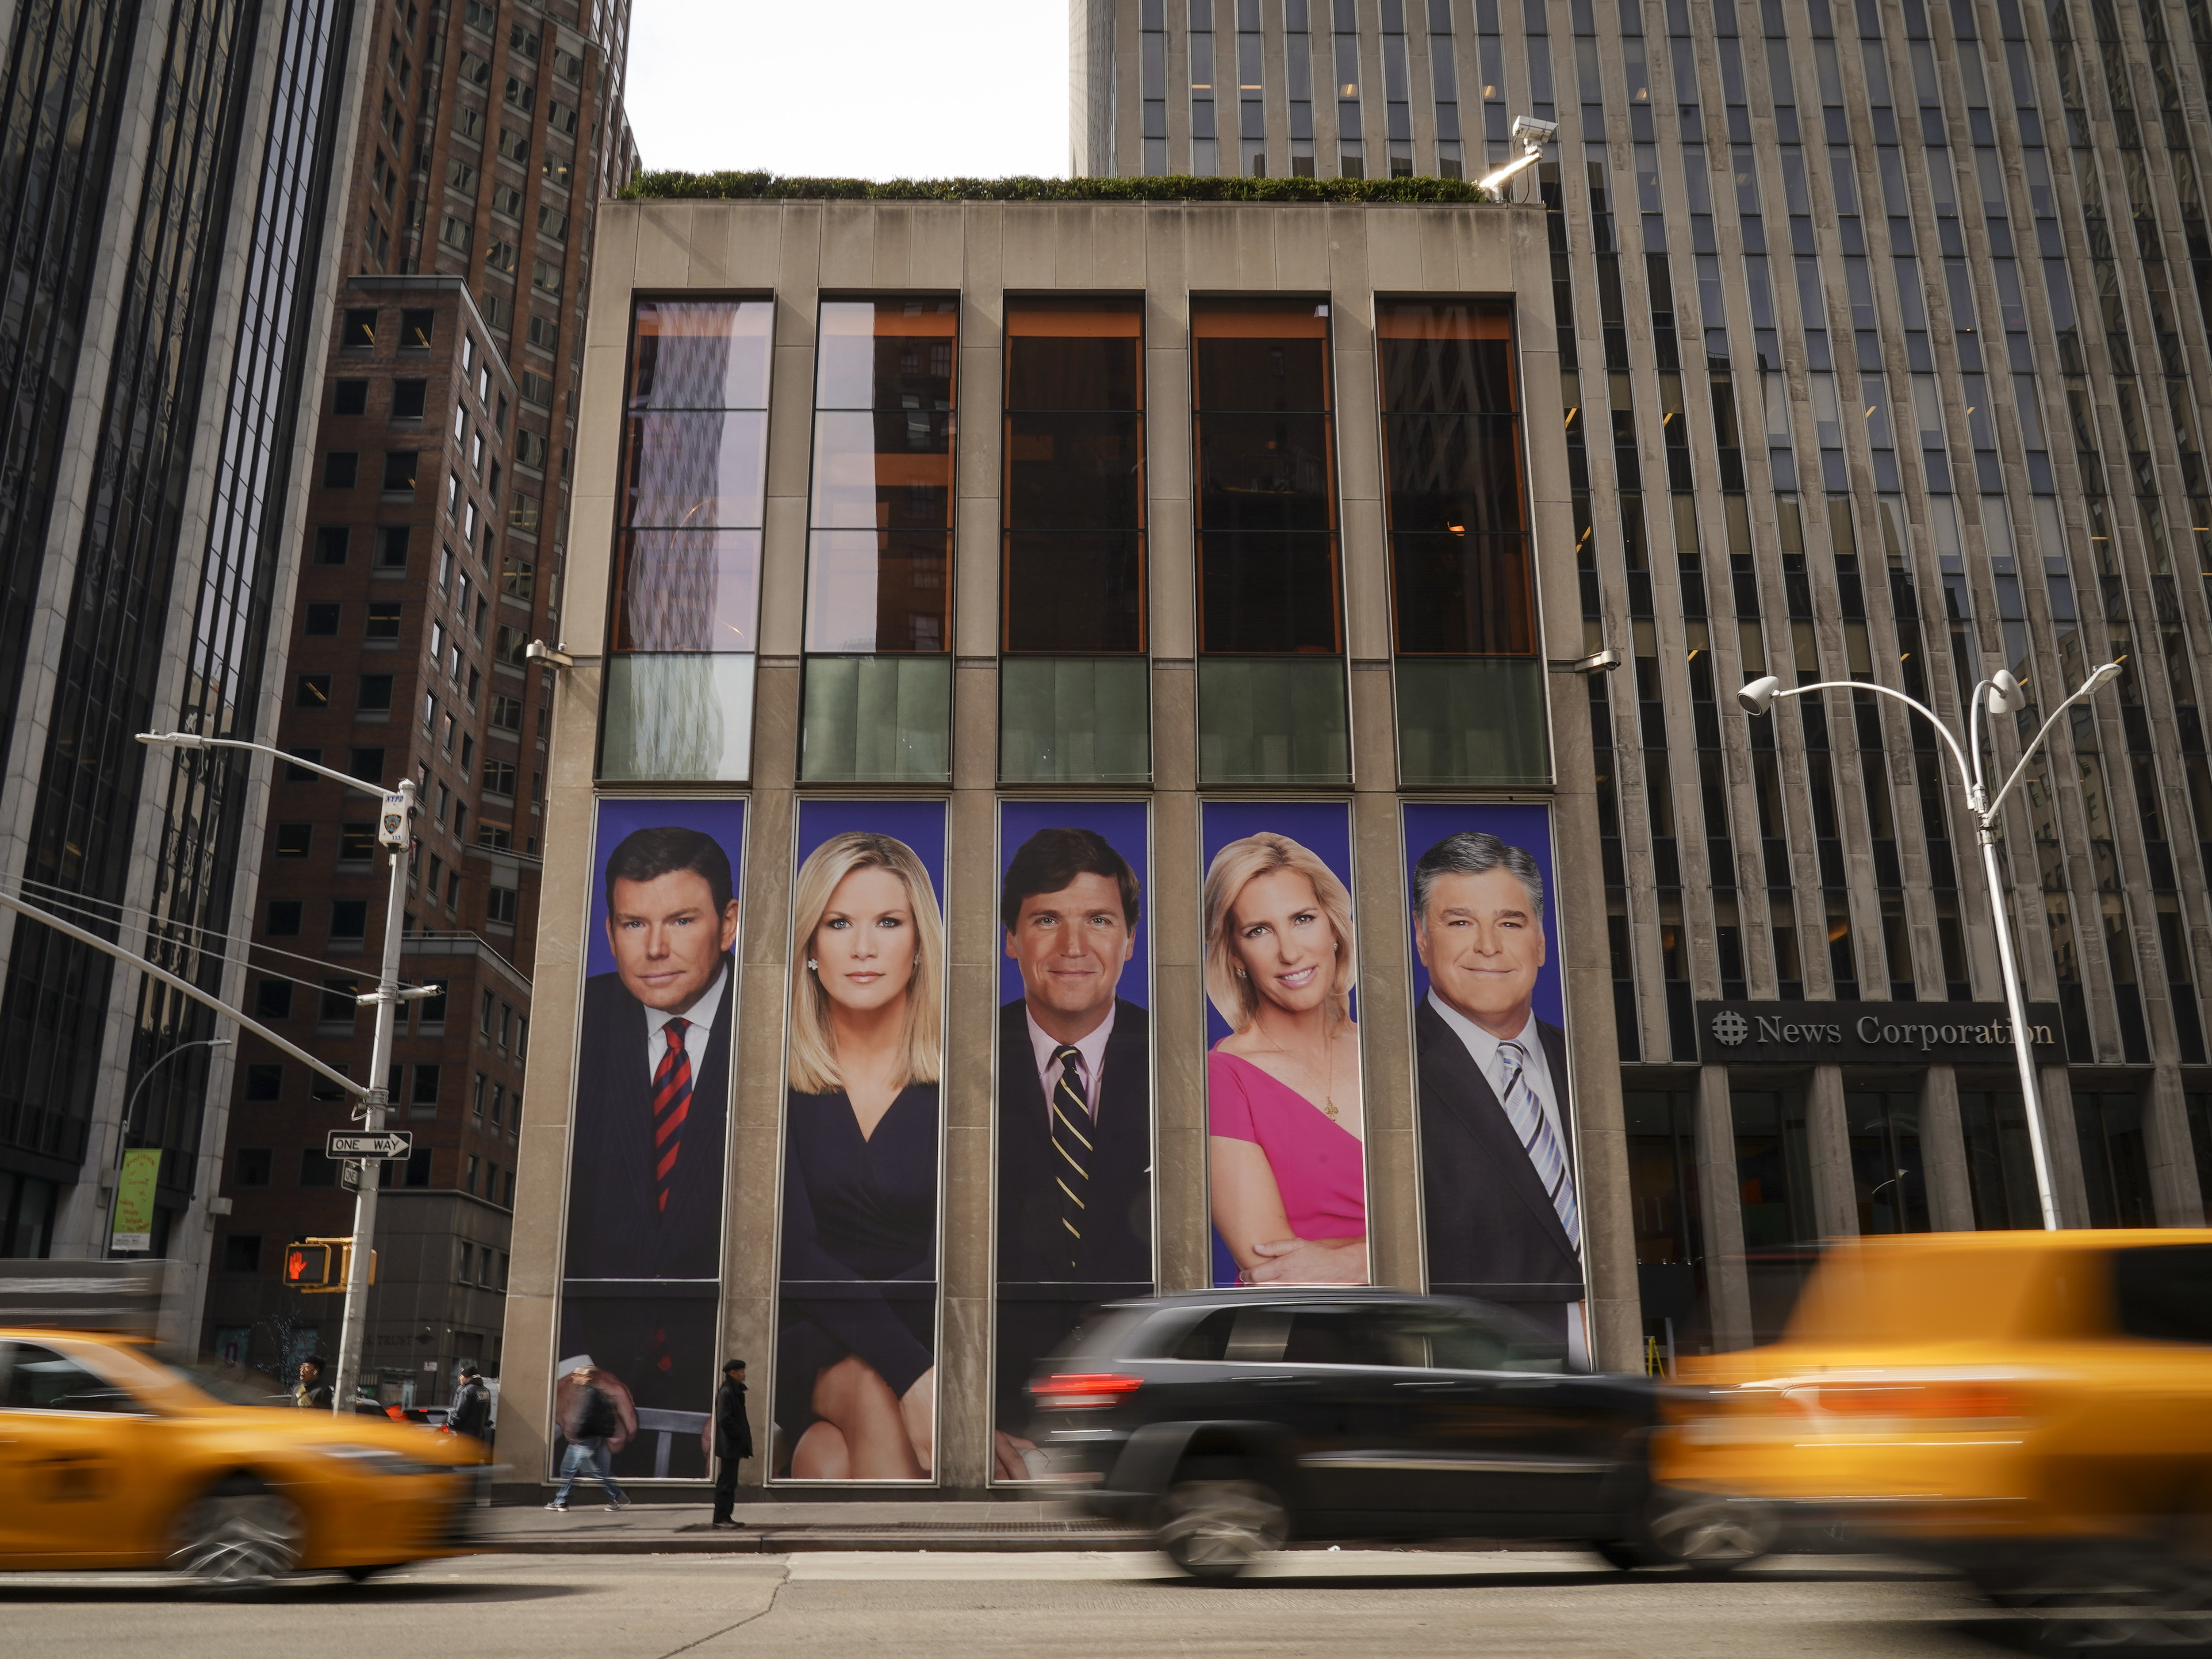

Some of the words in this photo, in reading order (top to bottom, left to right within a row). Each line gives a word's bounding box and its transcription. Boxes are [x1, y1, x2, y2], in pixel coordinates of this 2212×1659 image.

[1754, 1016, 1842, 1043] News
[336, 1139, 360, 1149] ONE
[374, 1140, 400, 1150] WAY
[377, 1335, 413, 1345] TRUST
